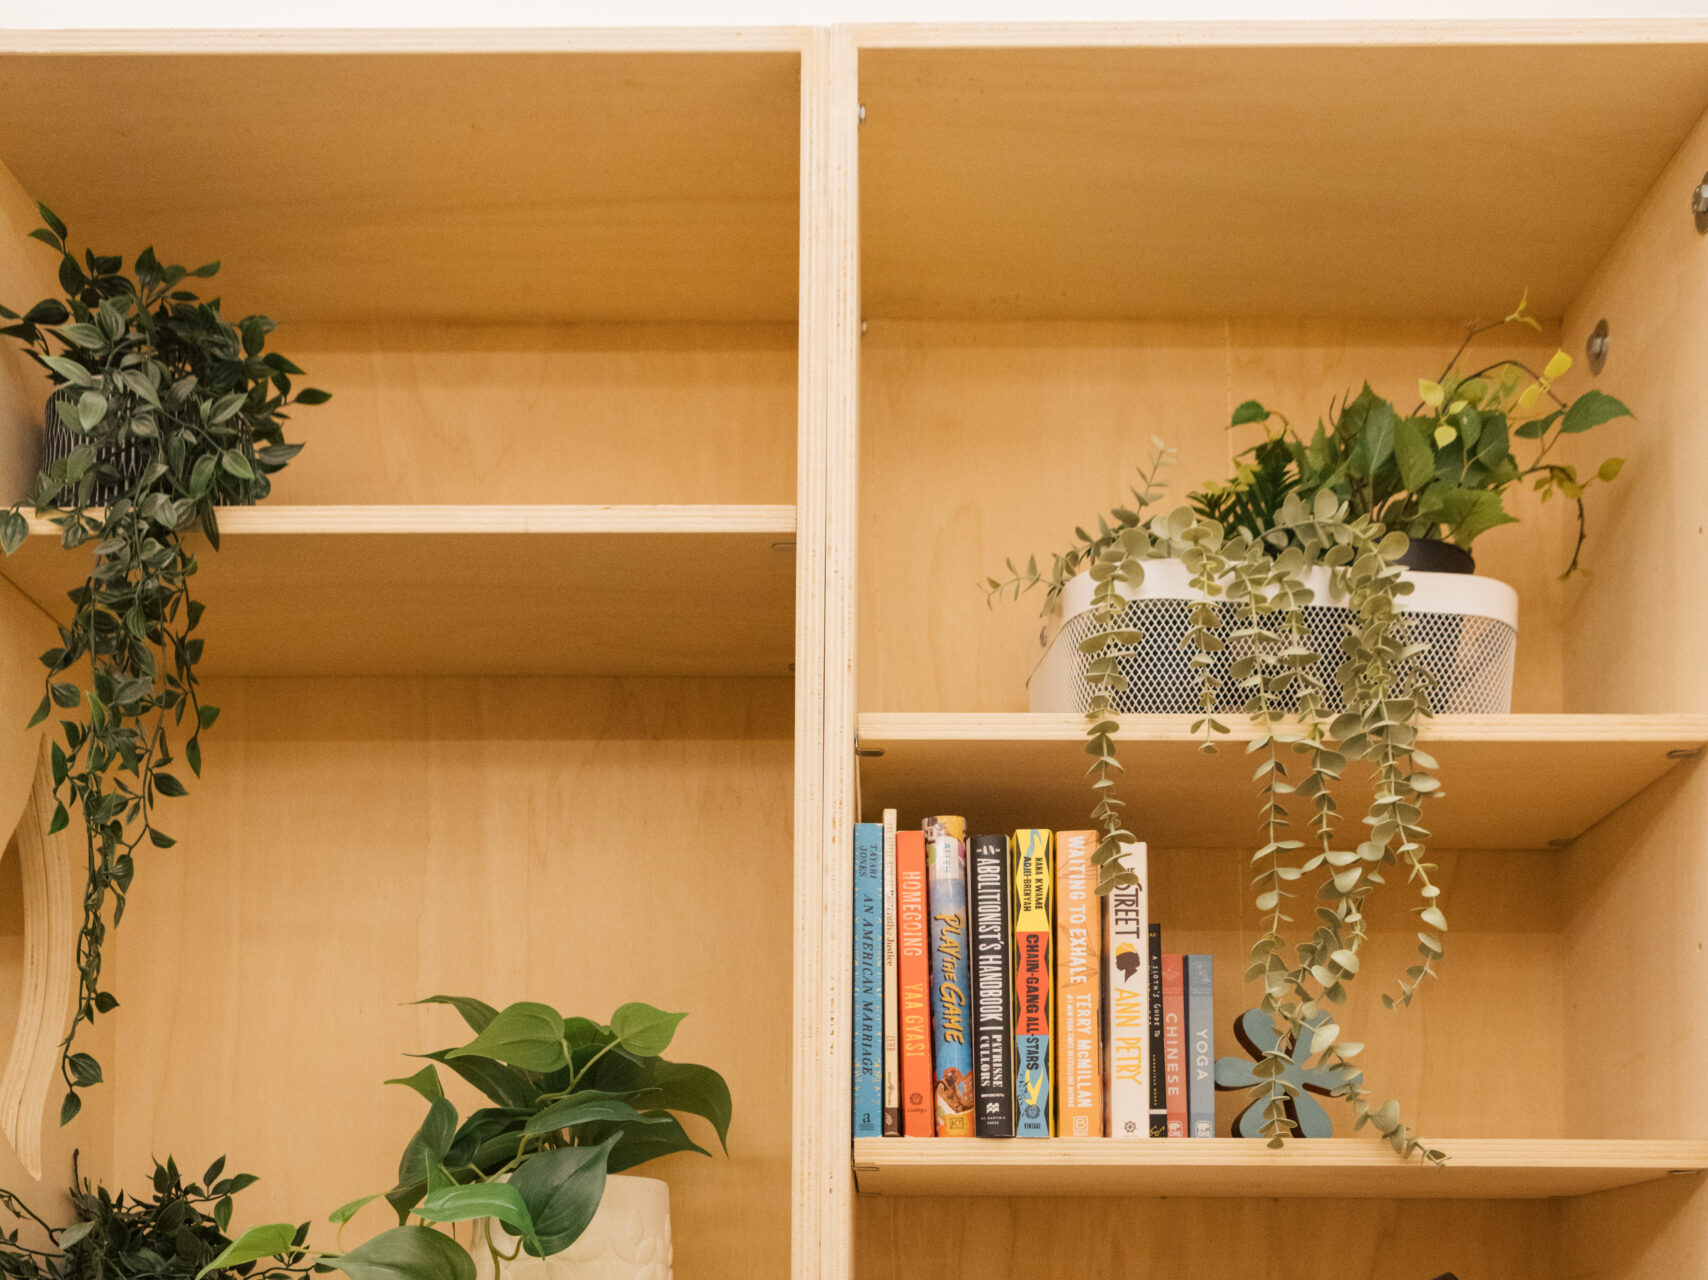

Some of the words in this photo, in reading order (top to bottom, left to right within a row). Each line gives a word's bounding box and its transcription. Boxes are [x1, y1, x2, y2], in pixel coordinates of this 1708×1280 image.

[858, 845, 868, 877] JONES
[869, 844, 878, 879] TAYARI
[1023, 856, 1032, 912] ADJEI-BRENYAH
[1035, 857, 1043, 875] NANA
[1068, 835, 1086, 901] WAITING
[863, 894, 874, 914] AN
[902, 871, 923, 956] HOMEGOING
[976, 858, 1004, 951] ABOLITIONIST'S
[1035, 878, 1043, 910] KWAME
[1069, 904, 1086, 924] TO
[862, 919, 874, 995] AMERICAN
[886, 938, 894, 967] Justice
[933, 913, 962, 960] PLAY
[1070, 928, 1088, 984] EXHALE
[941, 957, 958, 982] THE
[978, 954, 1003, 1022] HANDBOOK
[1026, 933, 1040, 1014] CHAIN-GANG
[904, 983, 924, 1009] YAA
[940, 982, 966, 1045] GAME
[1075, 993, 1092, 1035] TERRY
[1114, 988, 1142, 1027] ANN
[862, 1000, 874, 1077] MARRIAGE
[905, 1015, 926, 1056] GYASI
[980, 1035, 991, 1087] CULLORS
[991, 1034, 1003, 1088] PATRISSE
[1026, 1016, 1040, 1071] ALL-STARS
[1115, 1037, 1143, 1086] PETRY
[1166, 1013, 1180, 1096] CHINESE
[1196, 1028, 1209, 1081] YOGA
[1076, 1040, 1093, 1108] McMILLAN
[1024, 1122, 1041, 1130] VINTAGE
